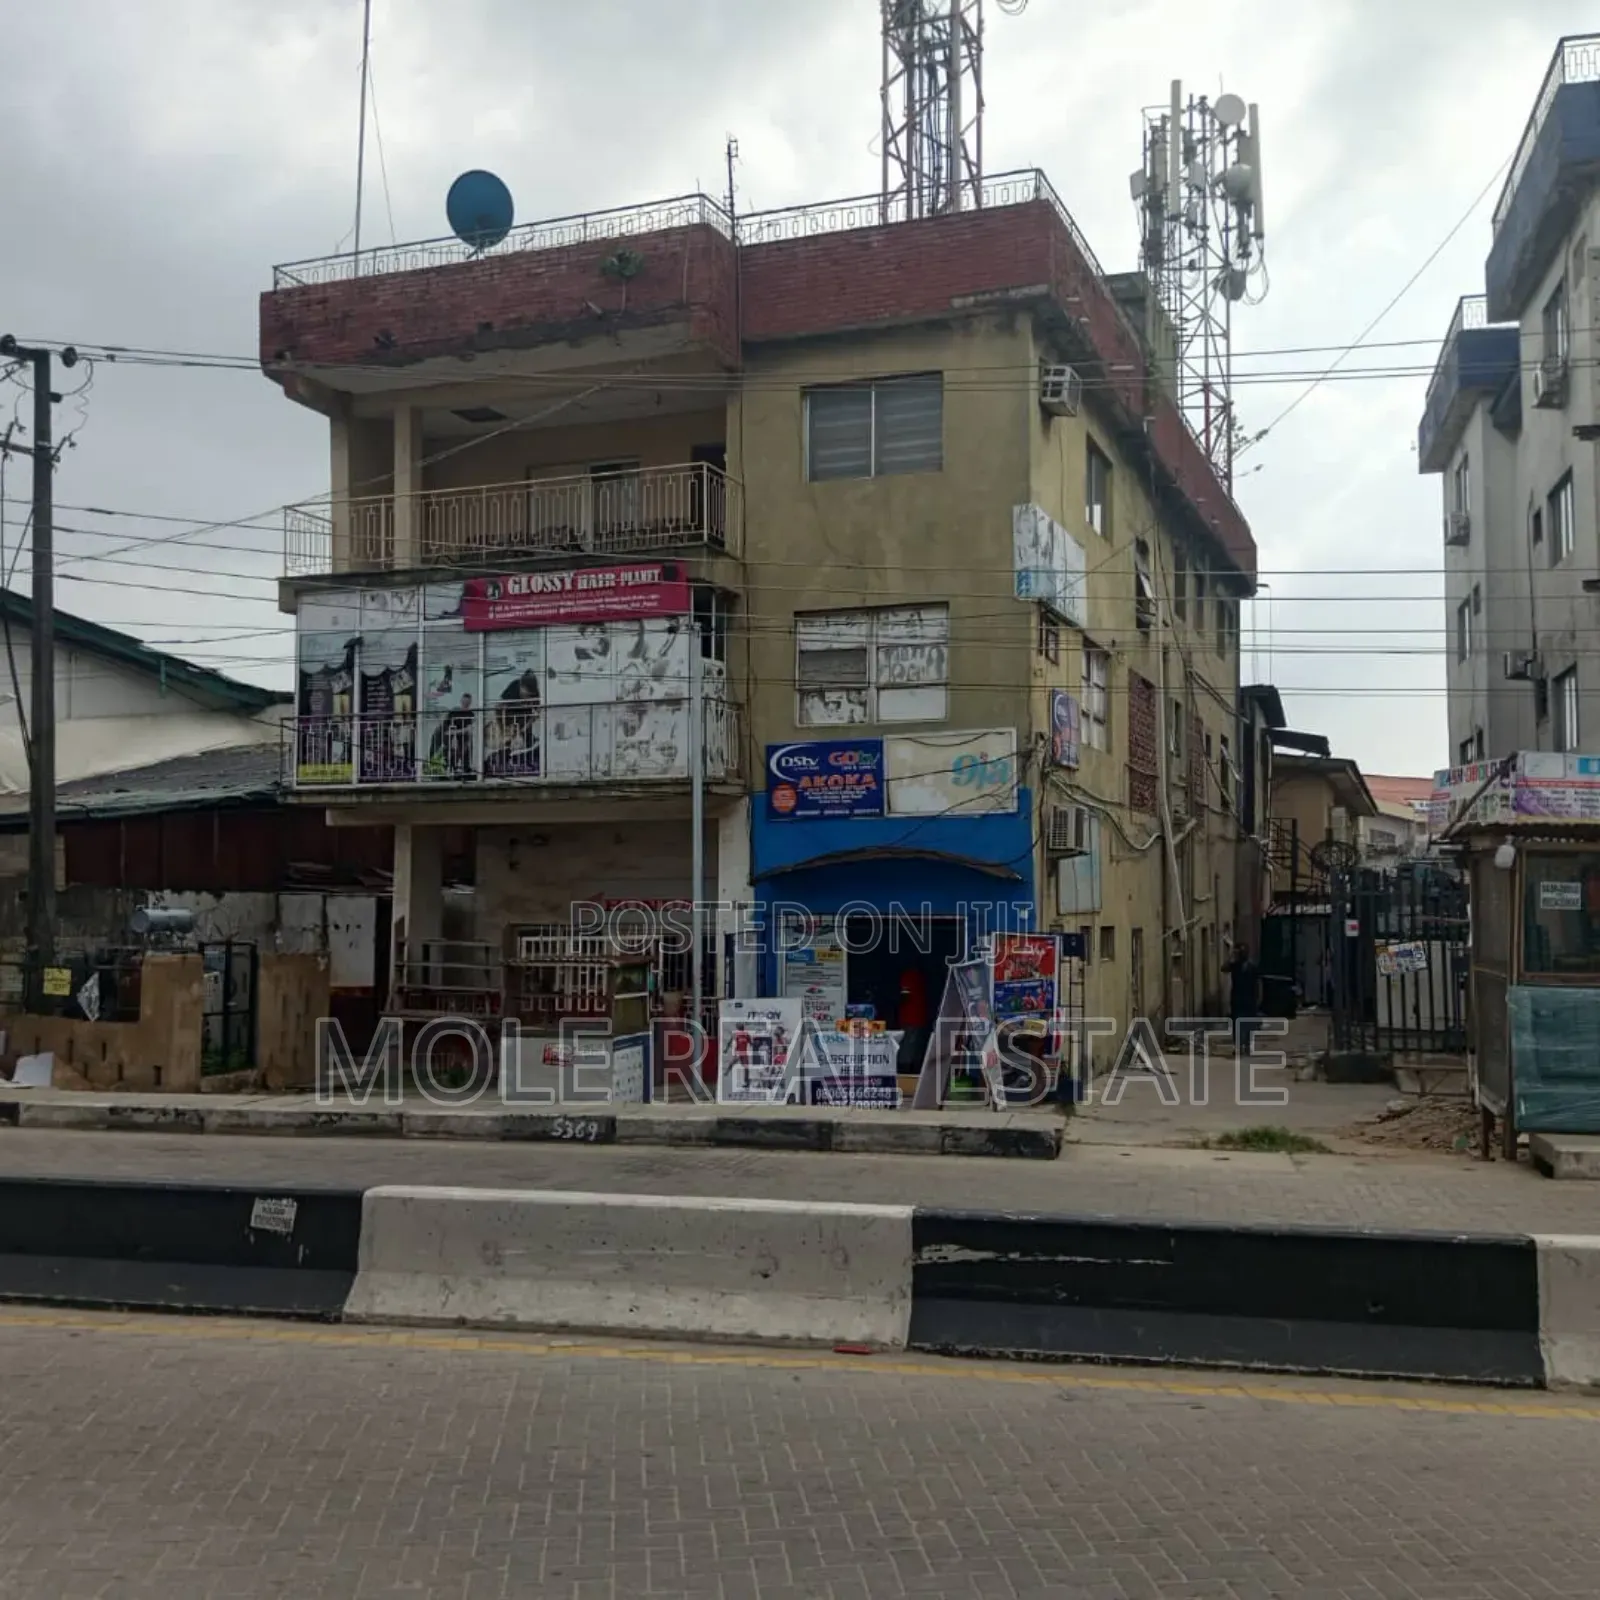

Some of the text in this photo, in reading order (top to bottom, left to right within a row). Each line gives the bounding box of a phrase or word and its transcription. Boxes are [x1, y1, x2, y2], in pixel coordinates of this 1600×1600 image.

[508, 572, 575, 595] GLOSSY
[577, 573, 617, 590] HAIR
[781, 755, 820, 768] DStv
[800, 774, 878, 791] AKOKA
[551, 1117, 599, 1142] 5369
